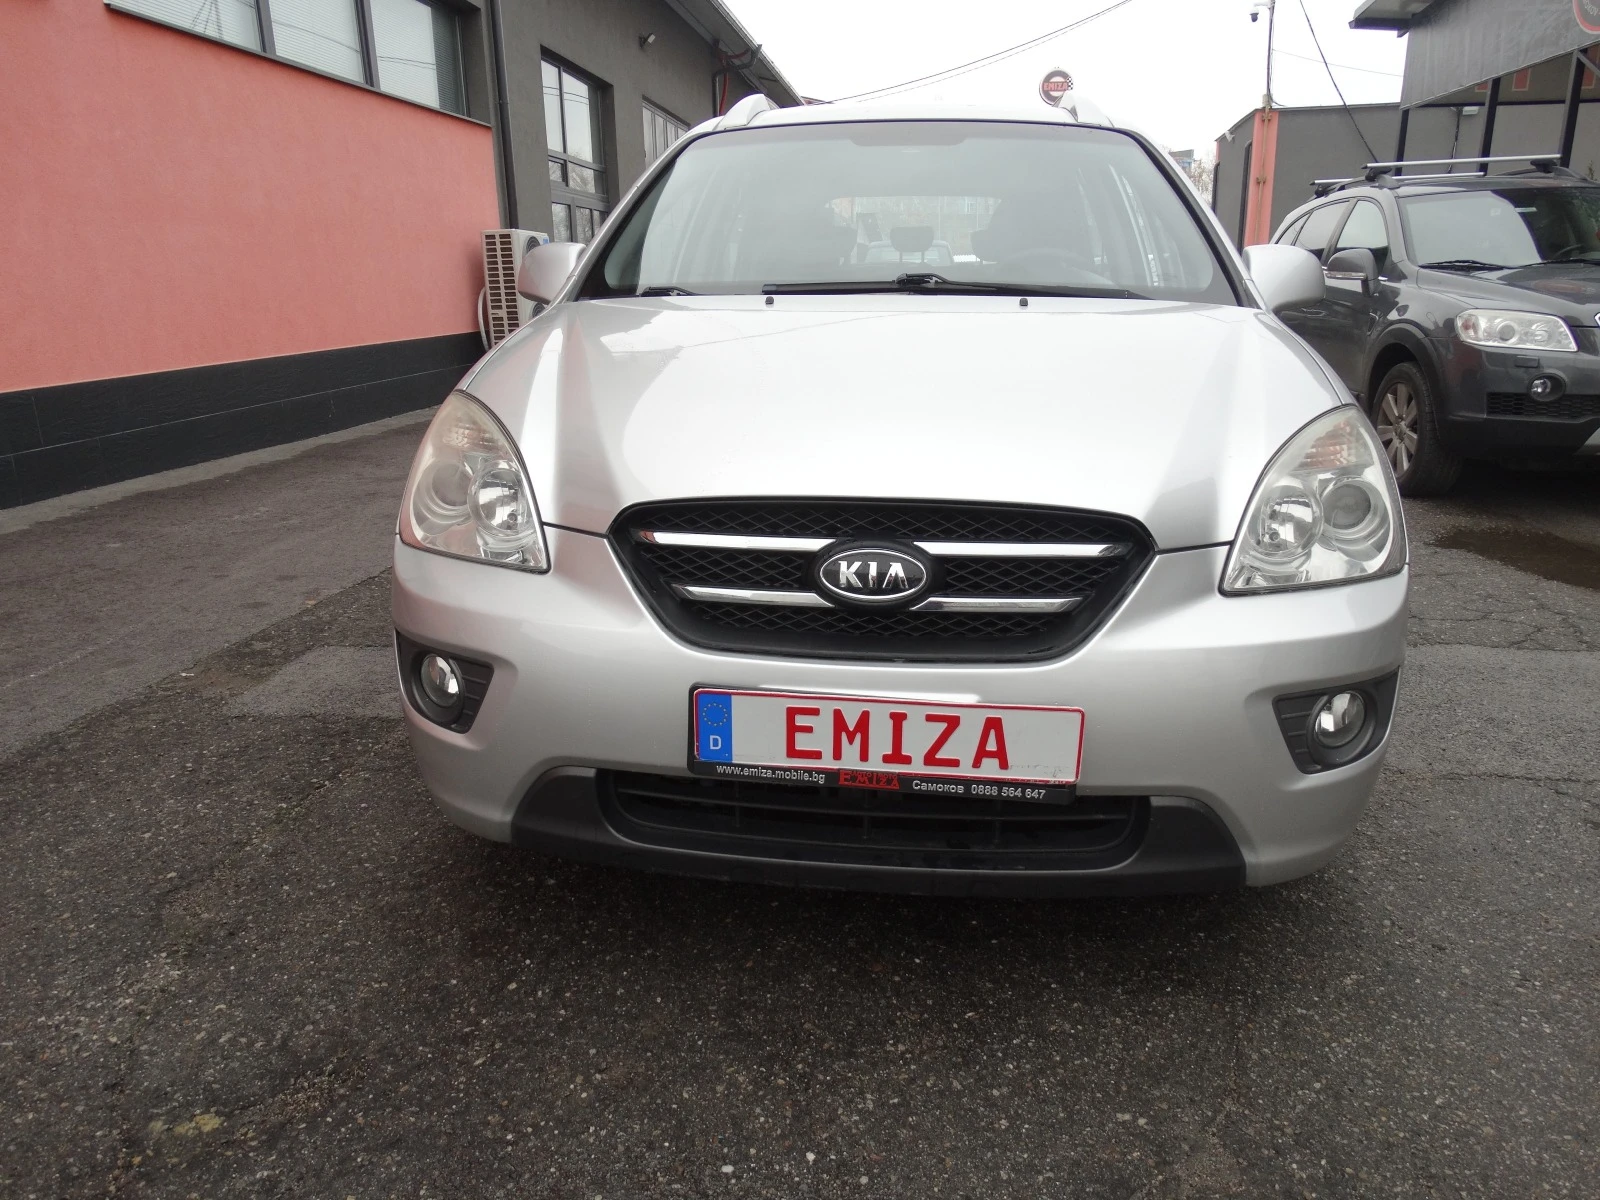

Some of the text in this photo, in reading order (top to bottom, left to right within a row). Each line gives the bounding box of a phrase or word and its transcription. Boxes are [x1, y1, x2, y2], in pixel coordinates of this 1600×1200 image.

[1043, 82, 1068, 91] EMIZA
[838, 560, 909, 589] KIA
[709, 734, 722, 750] D
[785, 705, 1010, 770] EMIZA
[716, 765, 826, 784] www.emiza.mobile.bg
[839, 769, 900, 790] EMIZA
[912, 780, 1046, 799] Самоков 0888 564 647
